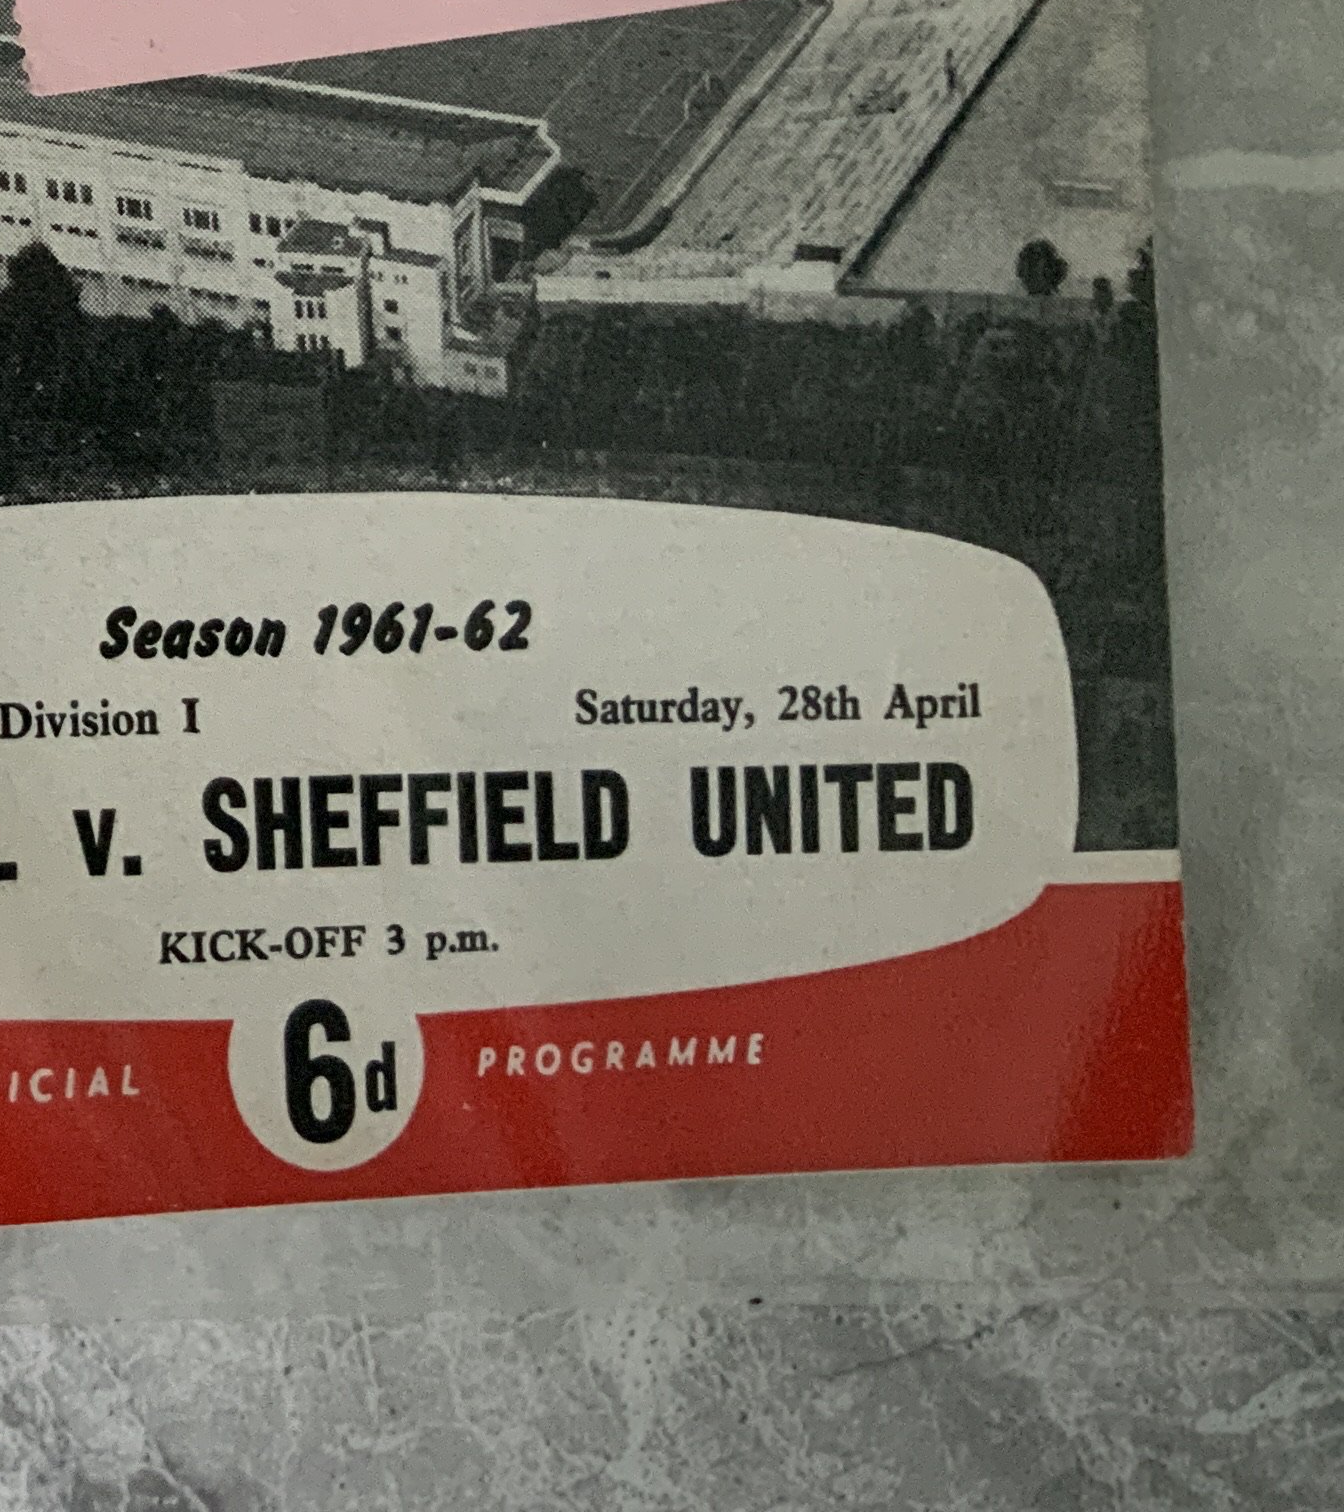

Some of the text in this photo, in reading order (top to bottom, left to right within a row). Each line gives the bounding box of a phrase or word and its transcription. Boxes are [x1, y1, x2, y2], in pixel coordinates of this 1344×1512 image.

[99, 599, 533, 659] Season 1961-62
[181, 697, 201, 734] I
[575, 687, 755, 731] Saturday,
[777, 684, 861, 721] 28th
[883, 683, 982, 728] April
[73, 807, 143, 877] v.
[202, 769, 630, 873] SHEFFIELD
[690, 761, 974, 858] UNITED
[160, 924, 499, 964] KICK-OFF 3 p.m.
[284, 998, 398, 1144] 6d
[478, 1033, 765, 1077] PROGRAMME
